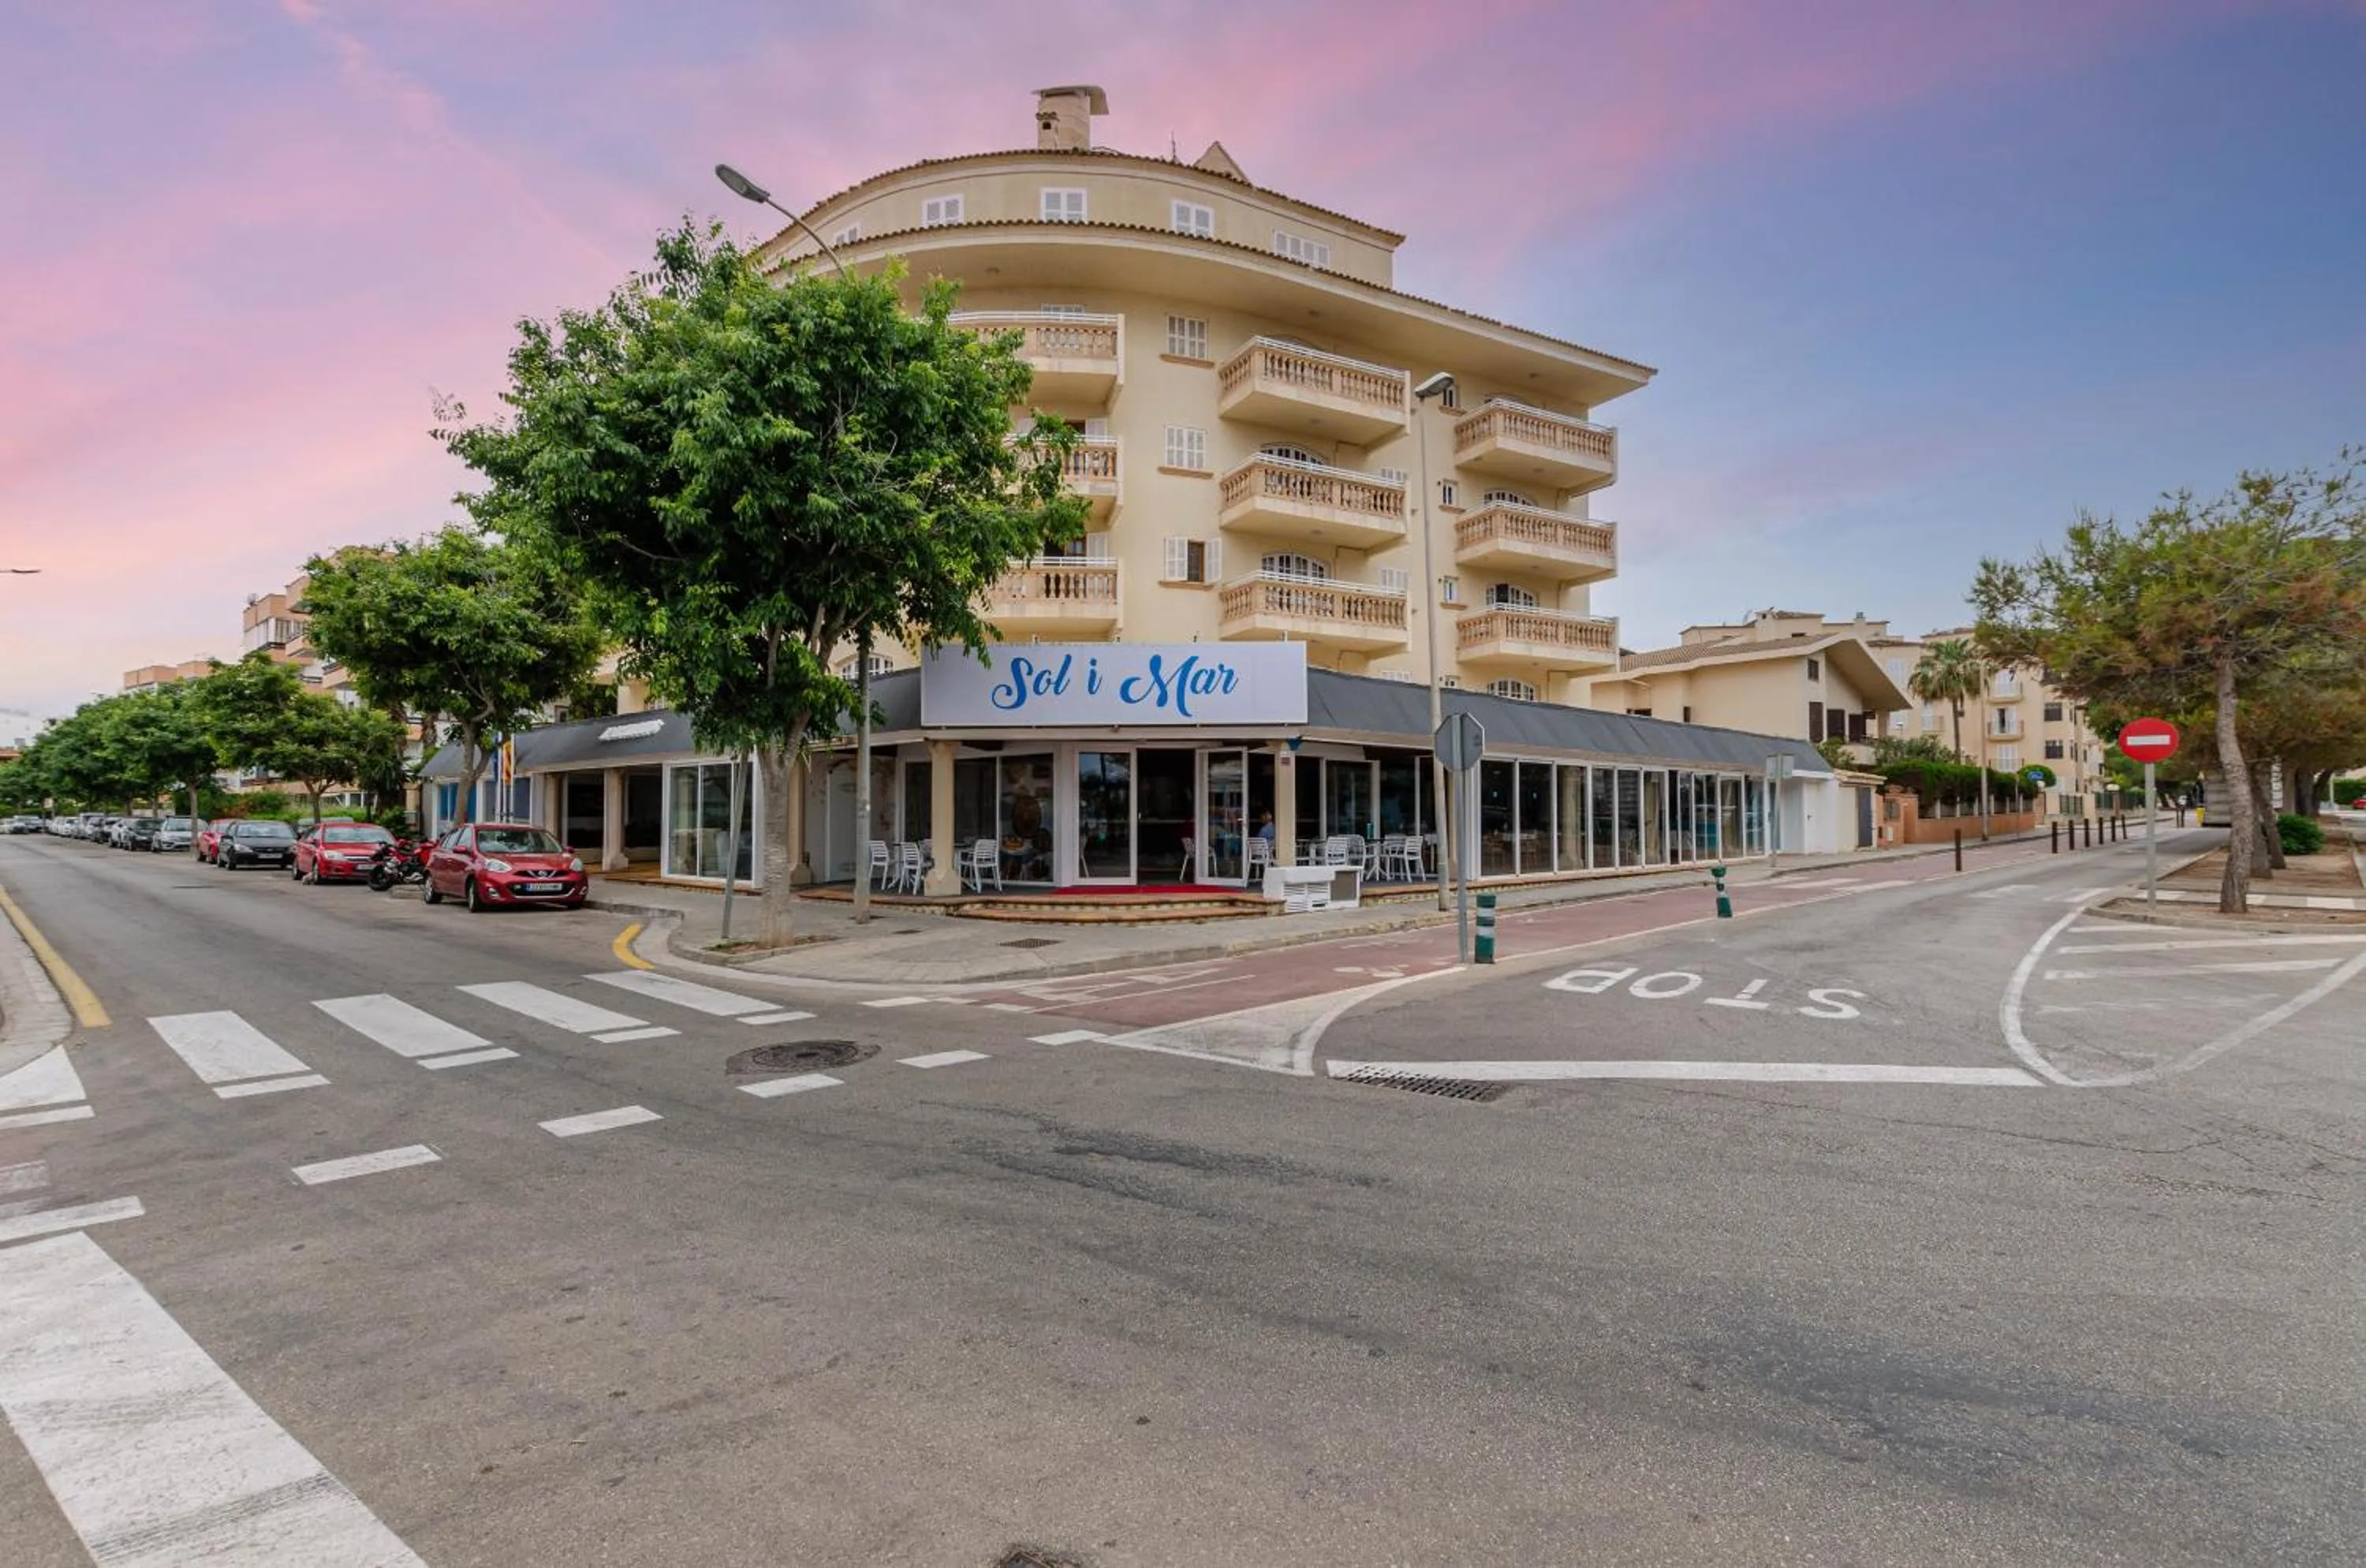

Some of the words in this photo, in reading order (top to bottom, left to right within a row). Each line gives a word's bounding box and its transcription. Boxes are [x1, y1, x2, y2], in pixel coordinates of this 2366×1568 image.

[992, 654, 1071, 709] Sol
[1088, 658, 1103, 695] i
[1120, 654, 1238, 716] Mar
[1540, 967, 1867, 1019] STOP
